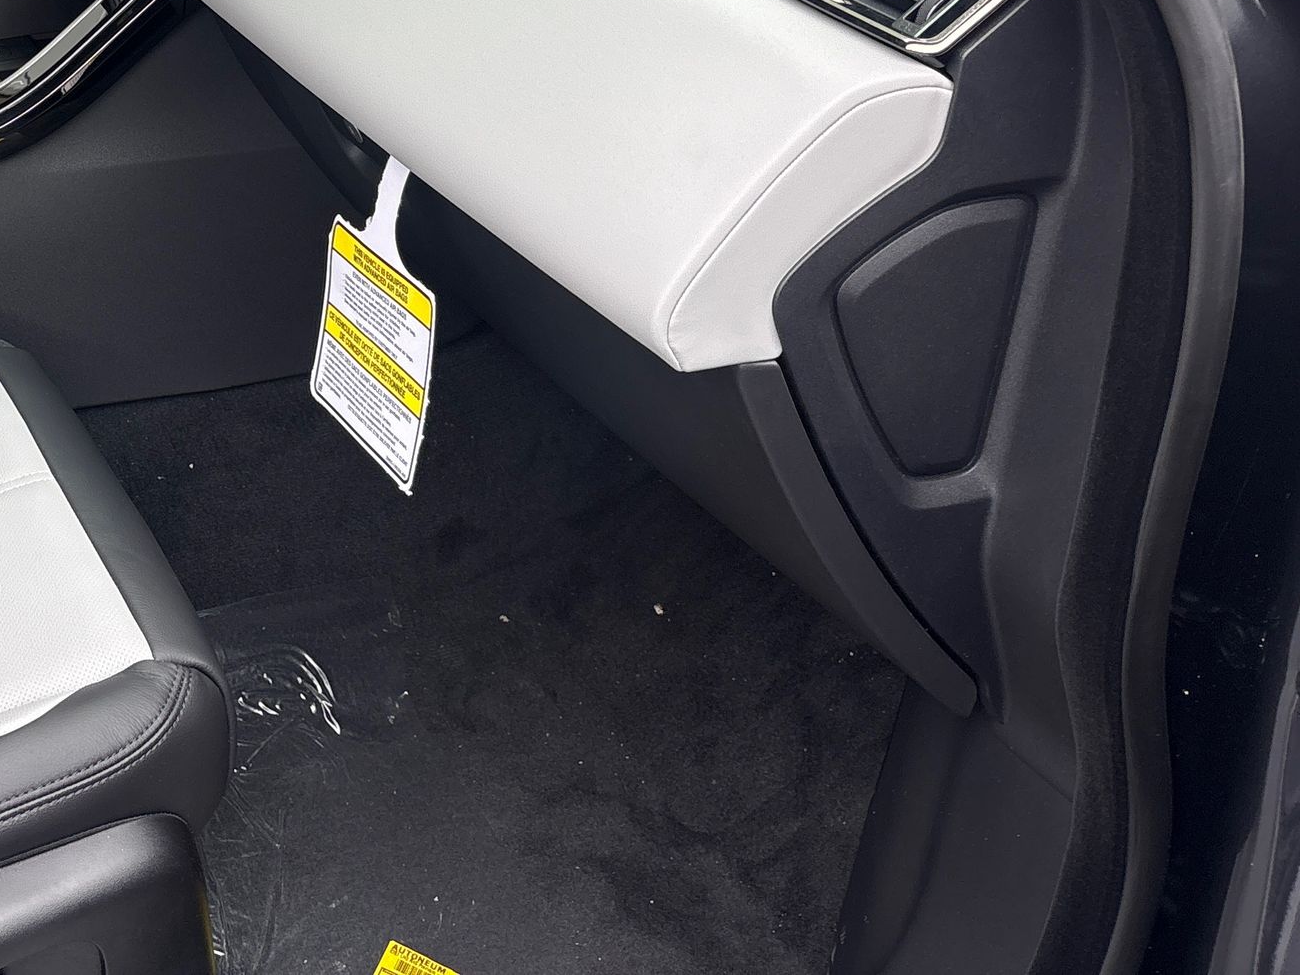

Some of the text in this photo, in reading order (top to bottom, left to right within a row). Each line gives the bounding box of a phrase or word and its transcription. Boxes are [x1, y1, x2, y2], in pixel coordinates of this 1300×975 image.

[353, 253, 363, 268] WITH
[364, 263, 386, 286] ADVANCED
[395, 288, 408, 304] BAGS
[354, 244, 362, 257] THIS
[364, 251, 380, 272] VEHICLE
[386, 271, 408, 295] EQUIPPED
[345, 338, 370, 366] CONCEPTION
[392, 944, 446, 974] AUTONEUM
